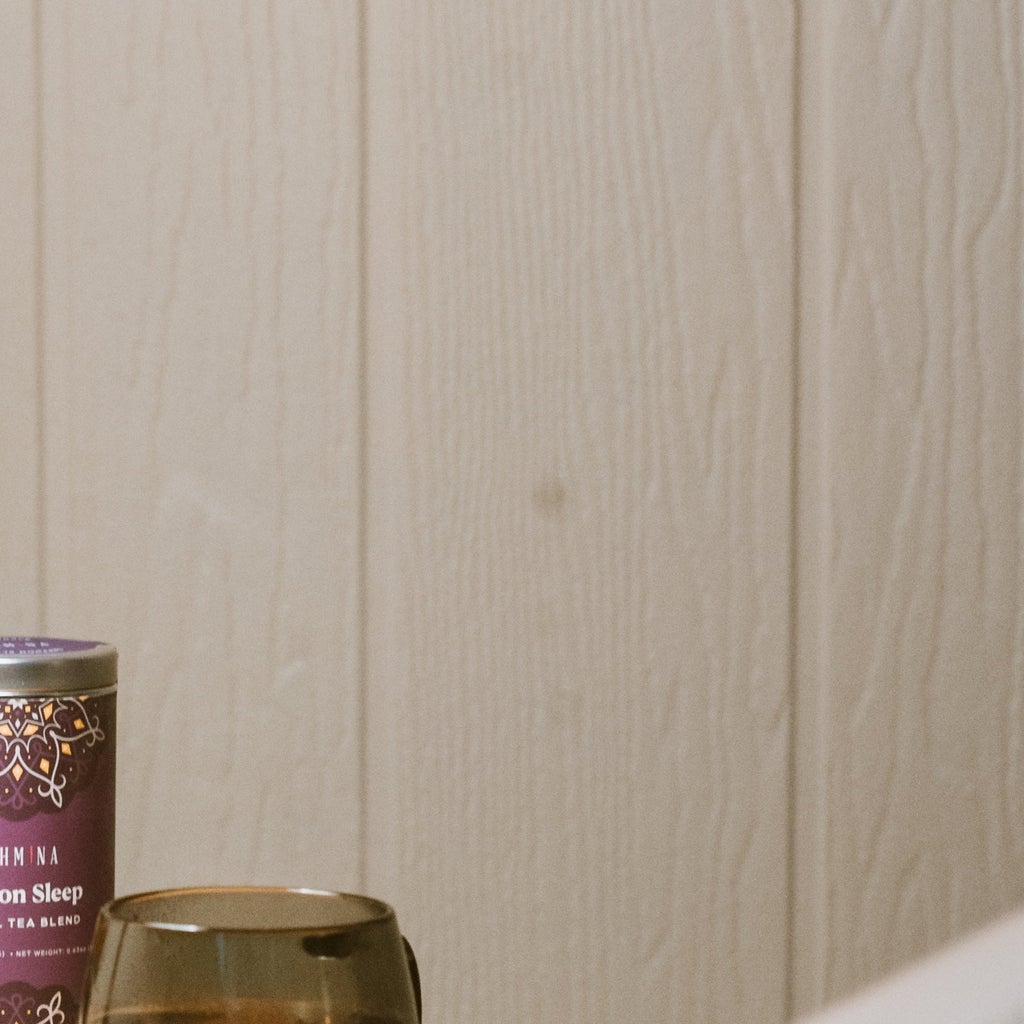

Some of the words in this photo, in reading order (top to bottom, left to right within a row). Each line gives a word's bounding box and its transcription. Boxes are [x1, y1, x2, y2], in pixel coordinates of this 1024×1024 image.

[31, 882, 83, 906] Sleep
[7, 917, 35, 929] TEA
[40, 914, 81, 928] BLEND
